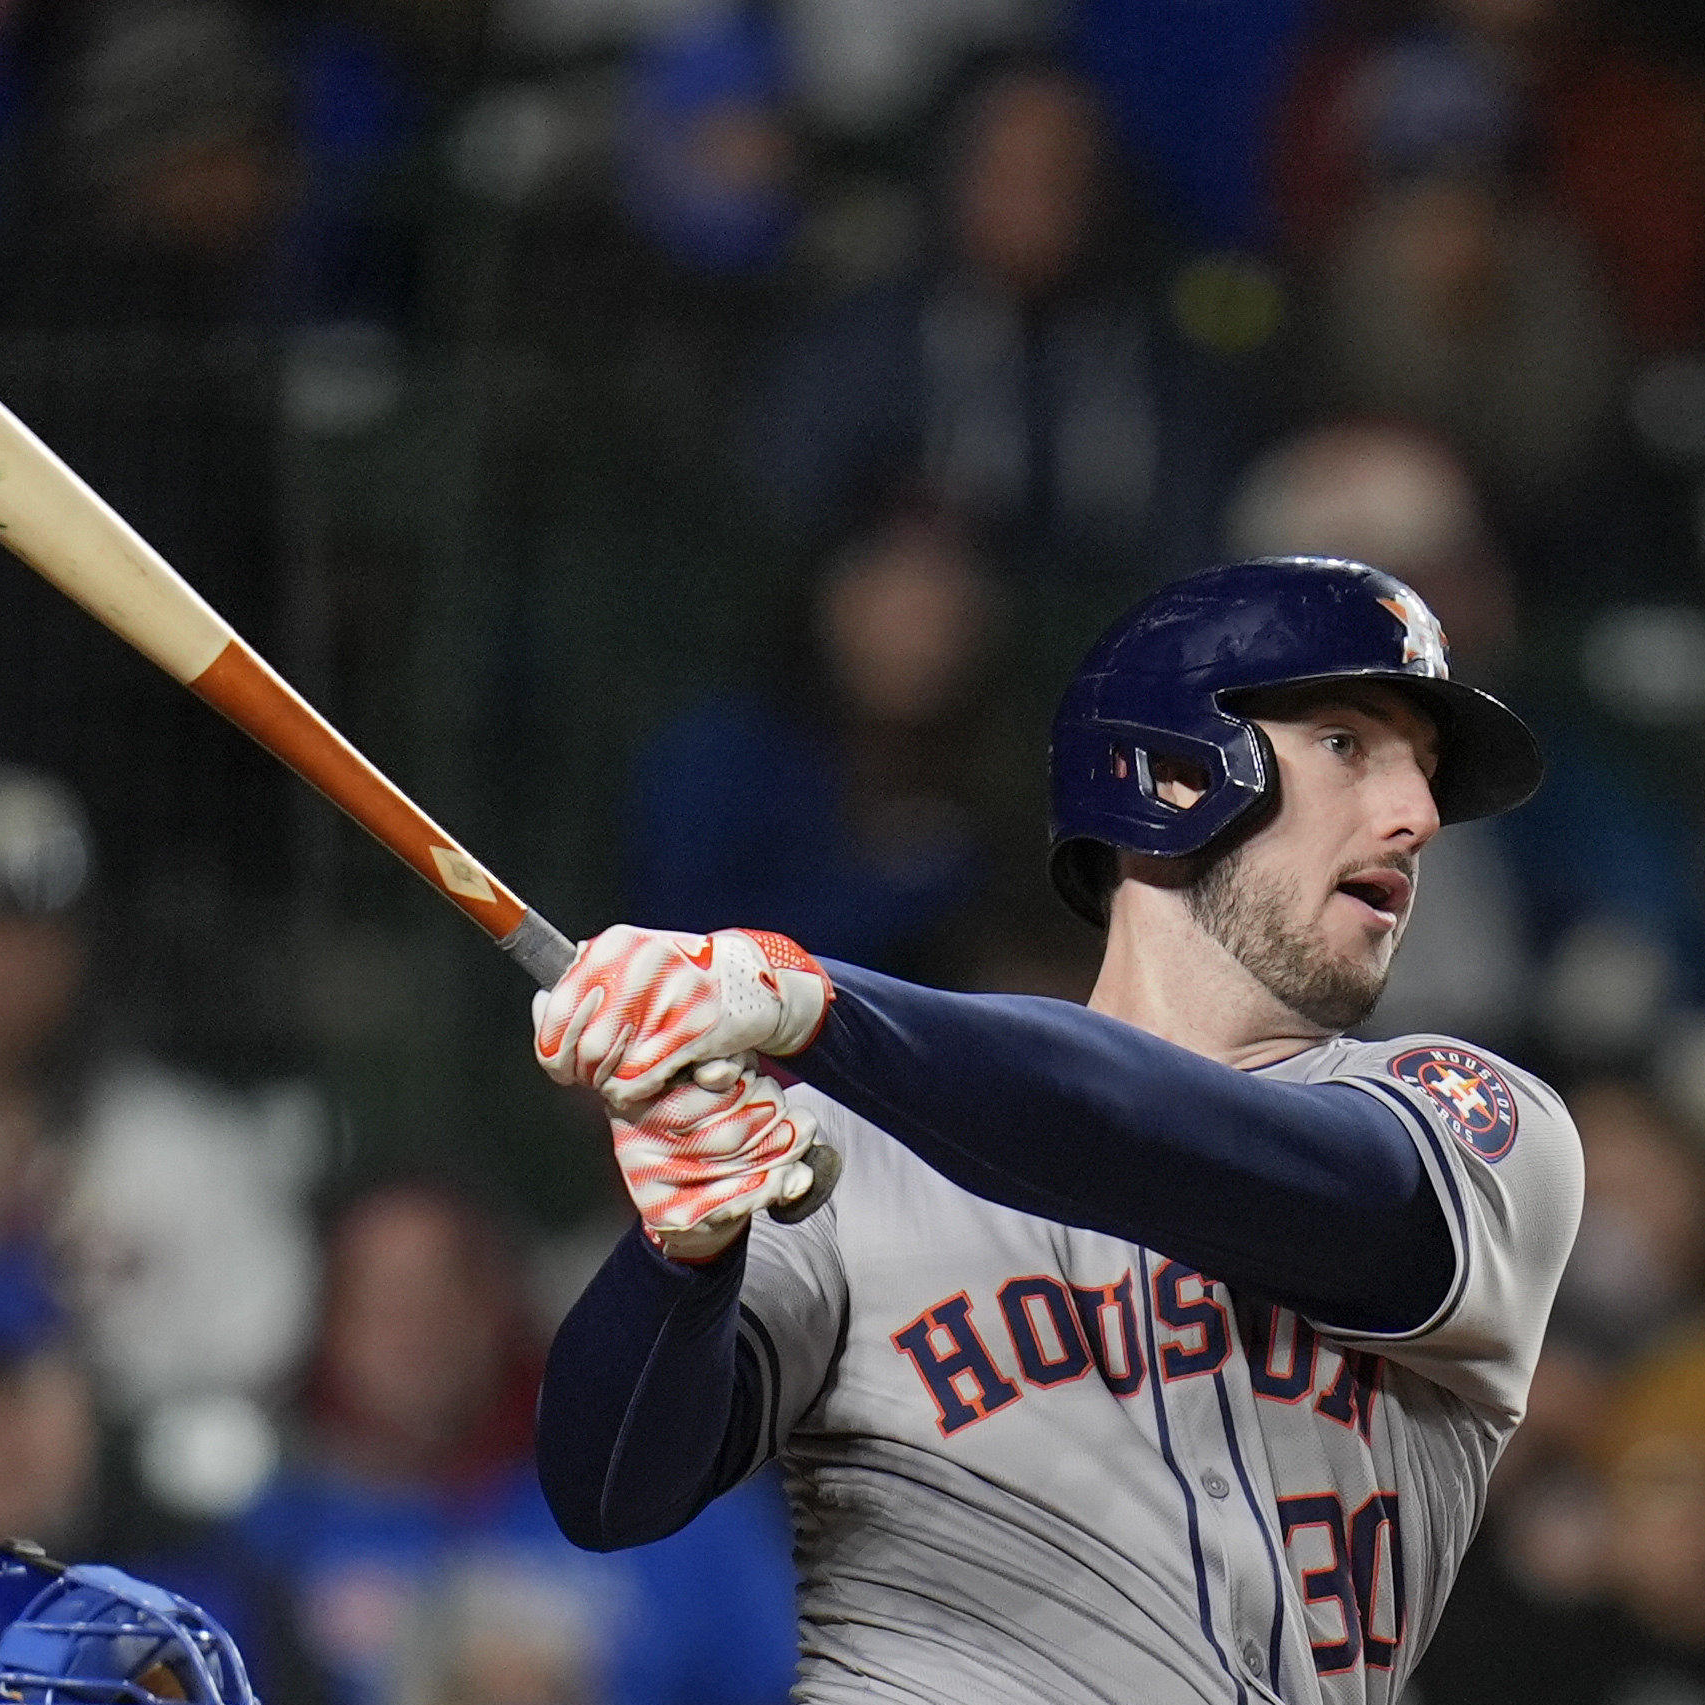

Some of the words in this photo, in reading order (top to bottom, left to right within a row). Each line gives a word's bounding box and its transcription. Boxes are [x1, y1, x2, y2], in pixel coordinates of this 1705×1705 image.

[1430, 1050, 1512, 1127] HOUSTON
[889, 1258, 1386, 1447] HOUSON
[1276, 1490, 1407, 1678] 30
